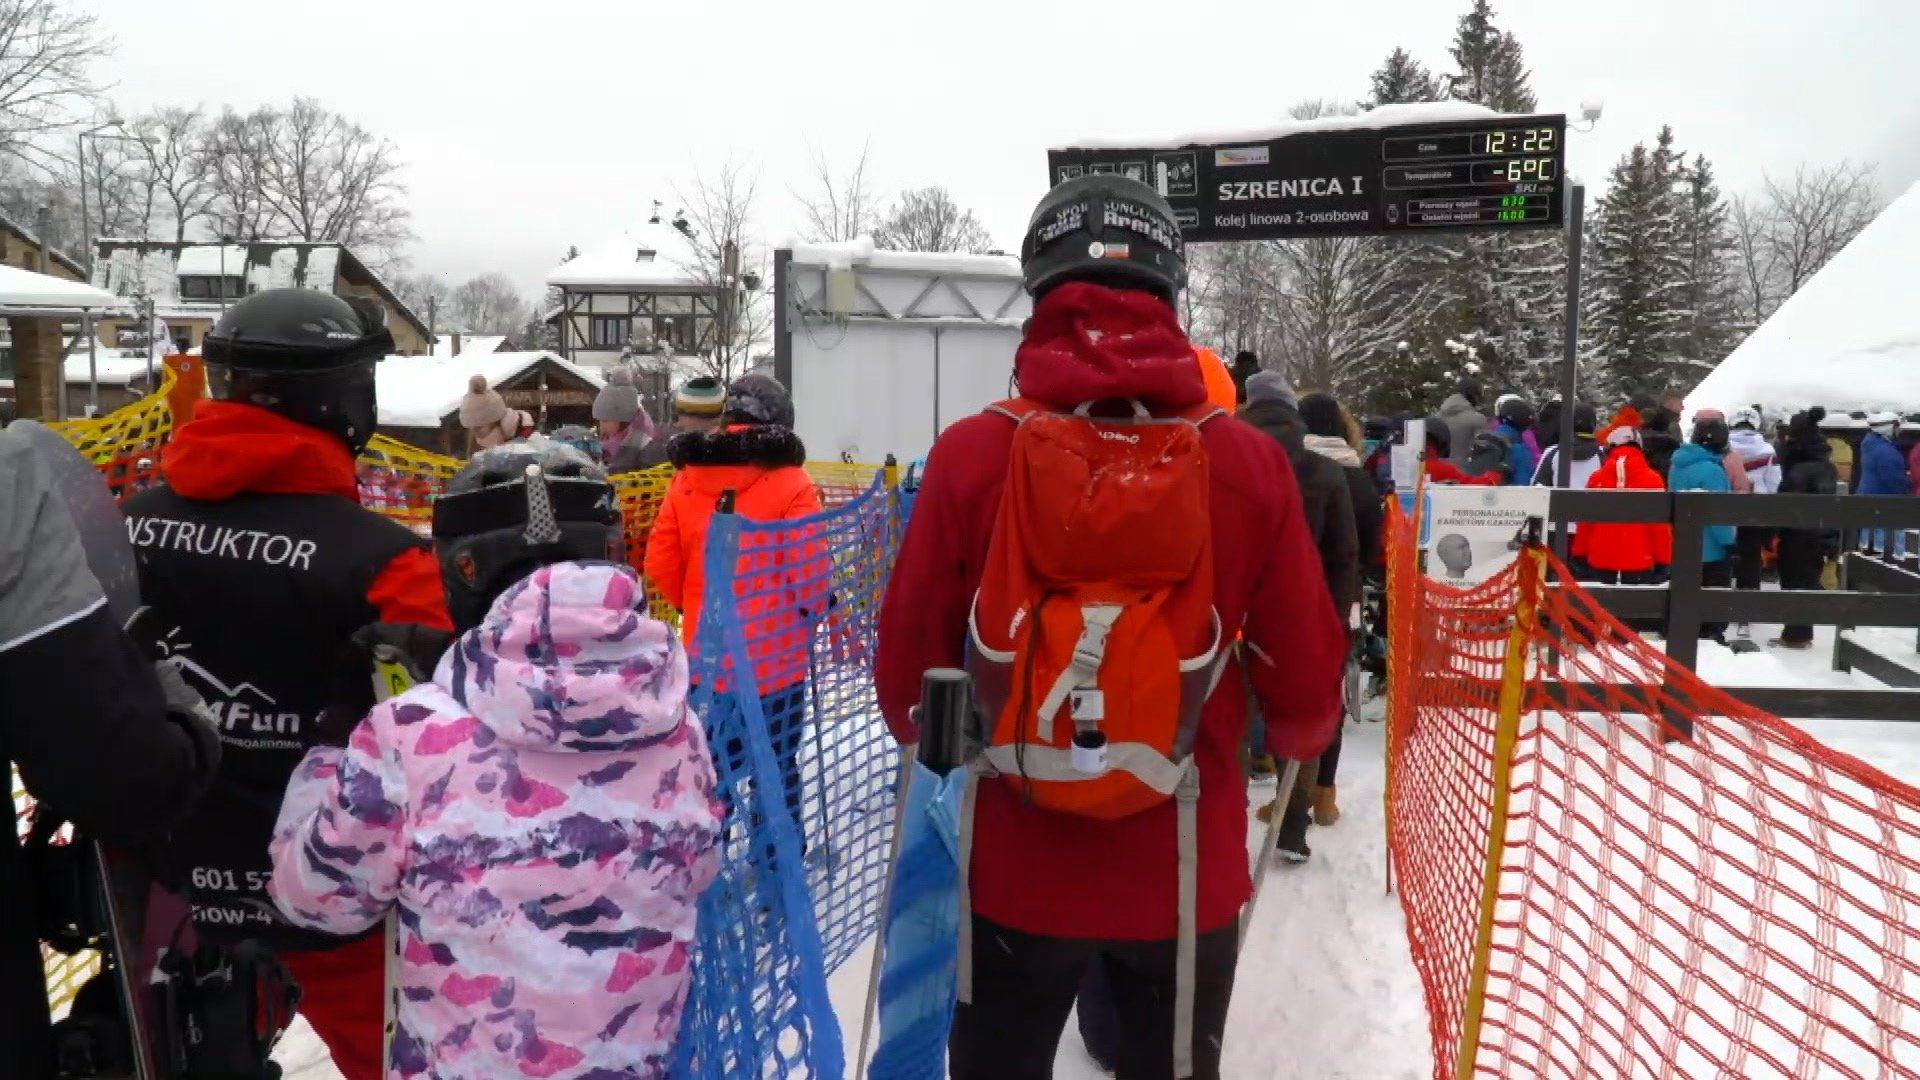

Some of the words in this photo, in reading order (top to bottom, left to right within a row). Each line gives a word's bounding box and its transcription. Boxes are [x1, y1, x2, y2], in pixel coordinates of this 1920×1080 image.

[1485, 129, 1553, 153] 12:22
[1218, 177, 1344, 201] SZRENICA
[1351, 175, 1363, 195] I
[1214, 213, 1246, 229] Kolej
[1250, 212, 1291, 226] linowa
[1295, 209, 1369, 224] 2-osobowa
[1452, 509, 1526, 517] PERSONALIZACJA
[124, 515, 317, 571] NSTRUKTOR
[208, 701, 300, 733] 4Fun
[191, 866, 239, 891] 601
